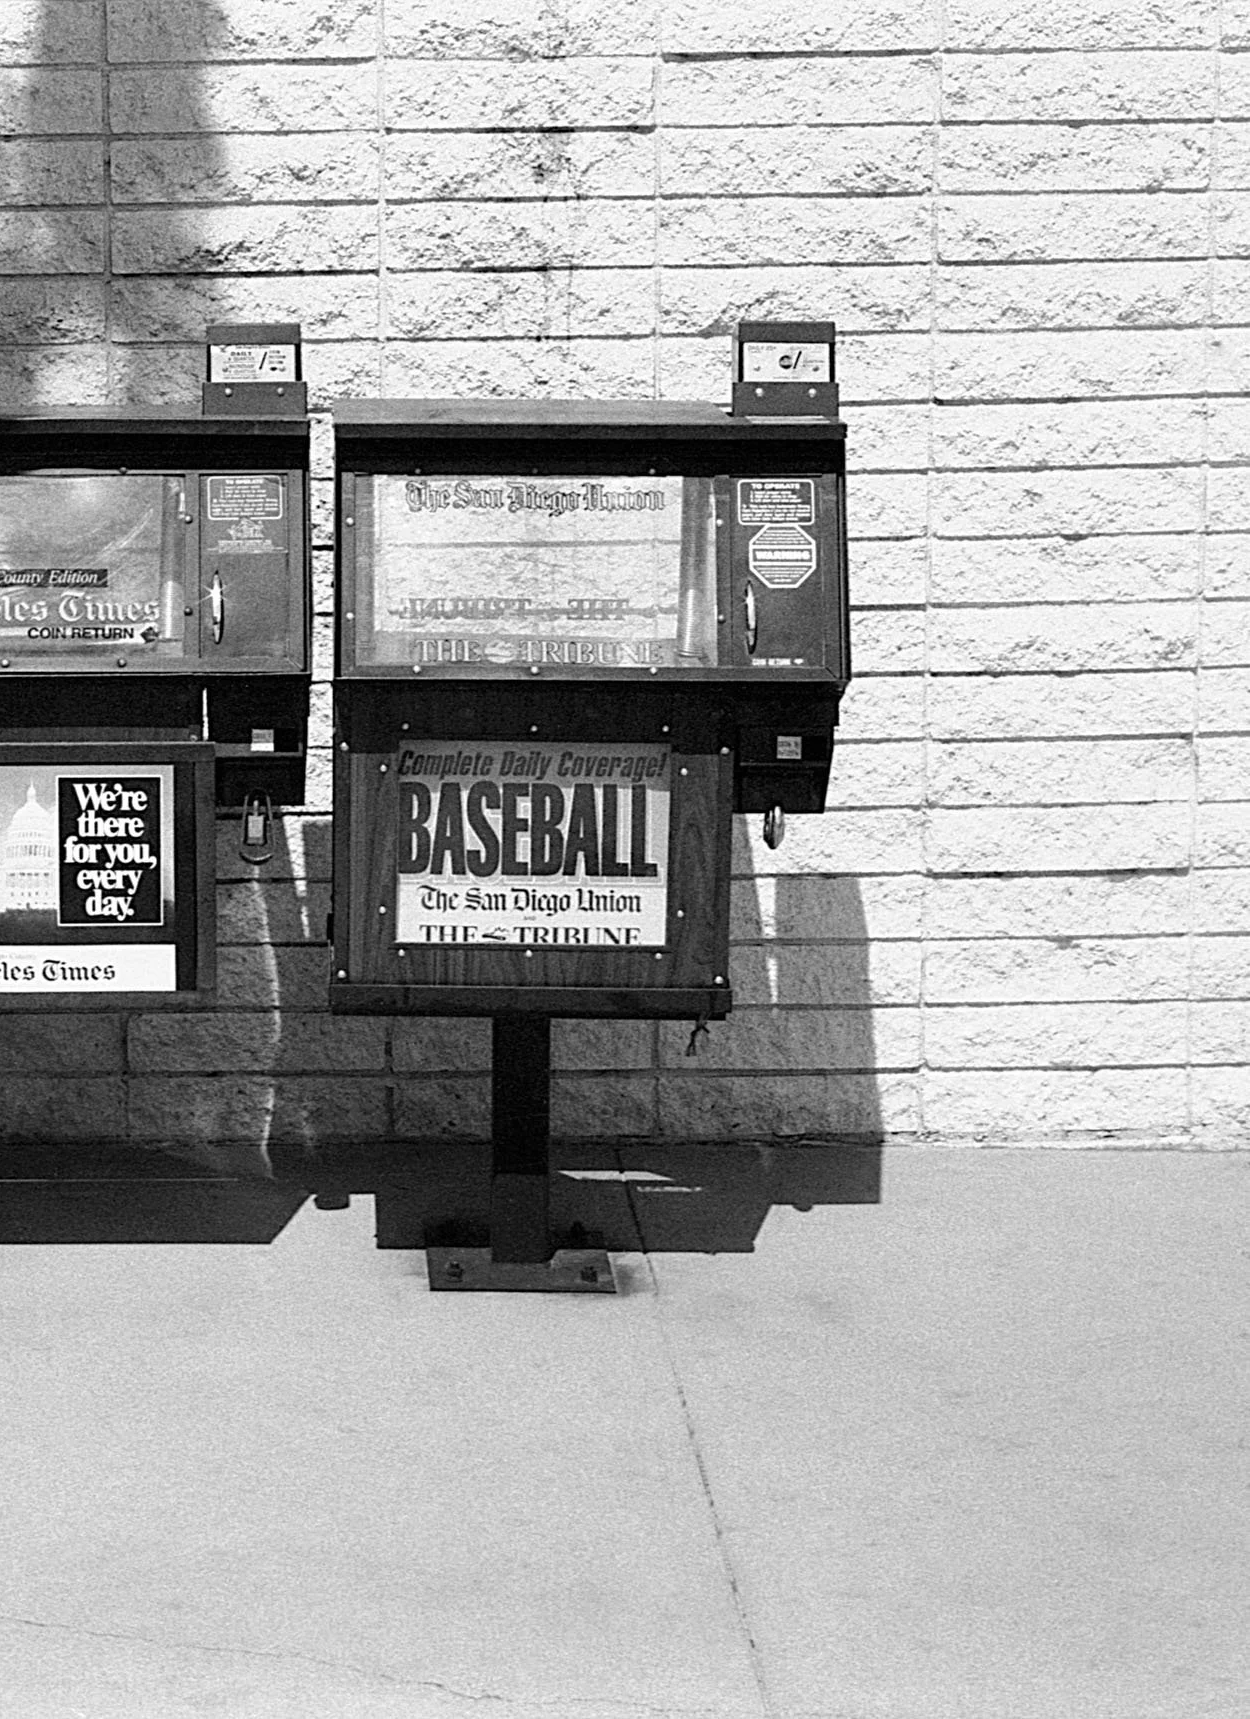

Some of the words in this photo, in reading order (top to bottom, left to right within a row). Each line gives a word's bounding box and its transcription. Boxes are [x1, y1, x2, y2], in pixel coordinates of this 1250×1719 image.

[406, 479, 450, 513] The
[453, 480, 504, 509] San
[506, 481, 580, 518] Diego
[583, 482, 665, 512] Union
[755, 550, 810, 560] WARNING
[49, 569, 99, 584] Edition
[58, 591, 160, 622] Times
[27, 627, 67, 640] COIN
[72, 627, 134, 640] RETURN
[415, 639, 481, 663] THE
[519, 640, 663, 666] TRIBUNE
[399, 750, 494, 780] Complete
[500, 751, 551, 779] Daily
[557, 752, 668, 782] Coverage!
[77, 810, 144, 837] there
[398, 781, 658, 877] BASEBALL
[64, 836, 102, 863] for
[103, 844, 157, 869] you,
[77, 869, 143, 895] every
[85, 889, 134, 921] day.
[418, 885, 459, 913] The
[464, 887, 507, 912] San
[511, 888, 571, 917] Diego
[576, 888, 642, 913] Union
[419, 925, 478, 942] THE
[42, 959, 116, 982] Times
